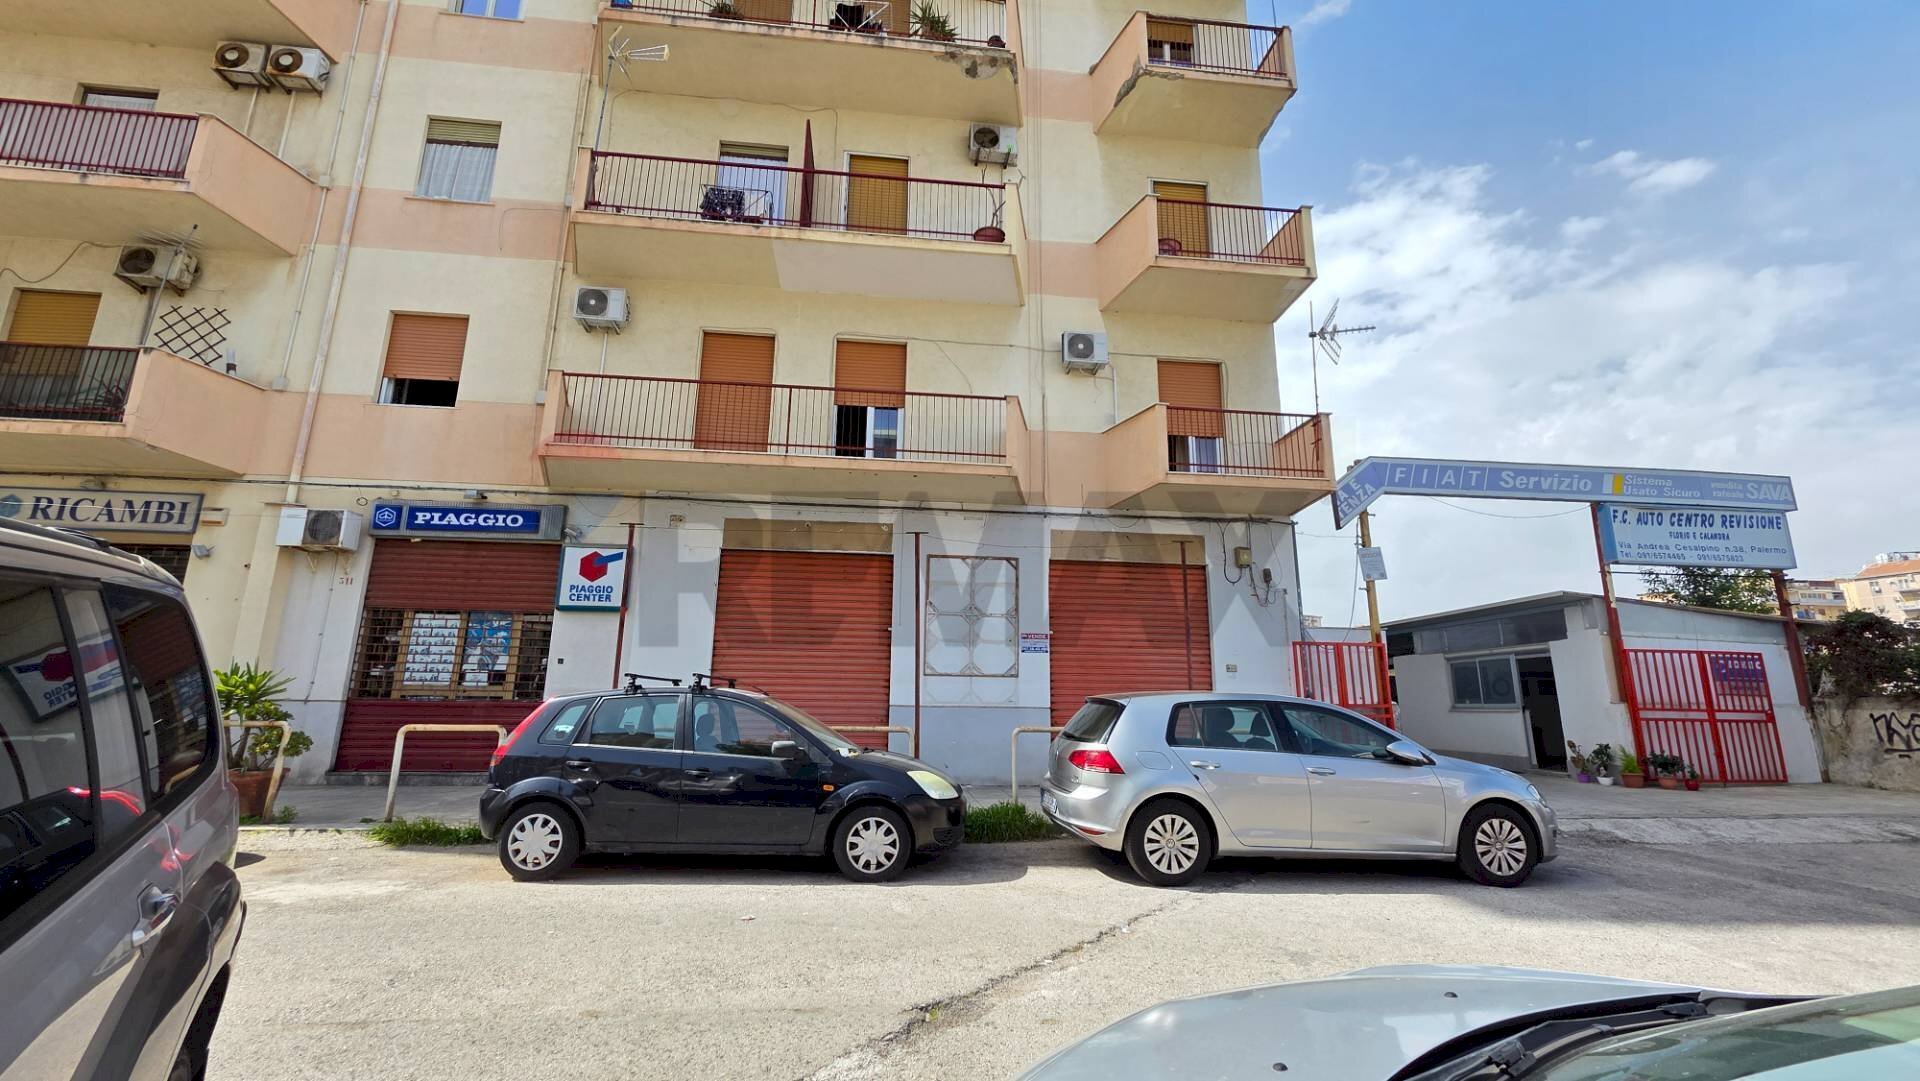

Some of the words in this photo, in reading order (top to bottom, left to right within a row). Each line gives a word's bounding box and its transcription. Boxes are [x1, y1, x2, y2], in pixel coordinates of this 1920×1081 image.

[1394, 467, 1481, 487] FIAT
[1500, 470, 1592, 492] Servizio
[1624, 474, 1673, 487] Sistema
[1624, 485, 1658, 497] Usato
[1663, 486, 1701, 498] Sicuro
[1746, 482, 1791, 501] SAVA
[28, 496, 192, 525] RICAMBI
[414, 512, 524, 527] PIAGGIO
[1636, 511, 1664, 526] AUTO
[1669, 512, 1715, 529] CENTRO
[1720, 514, 1782, 530] REVISIONE
[1618, 541, 1632, 549] Via
[1637, 543, 1670, 551] Andrea
[1674, 543, 1720, 553] Cesalpino
[1750, 545, 1788, 554] Palermo
[569, 584, 614, 594] PIAGGIO
[568, 593, 612, 602] CENTER
